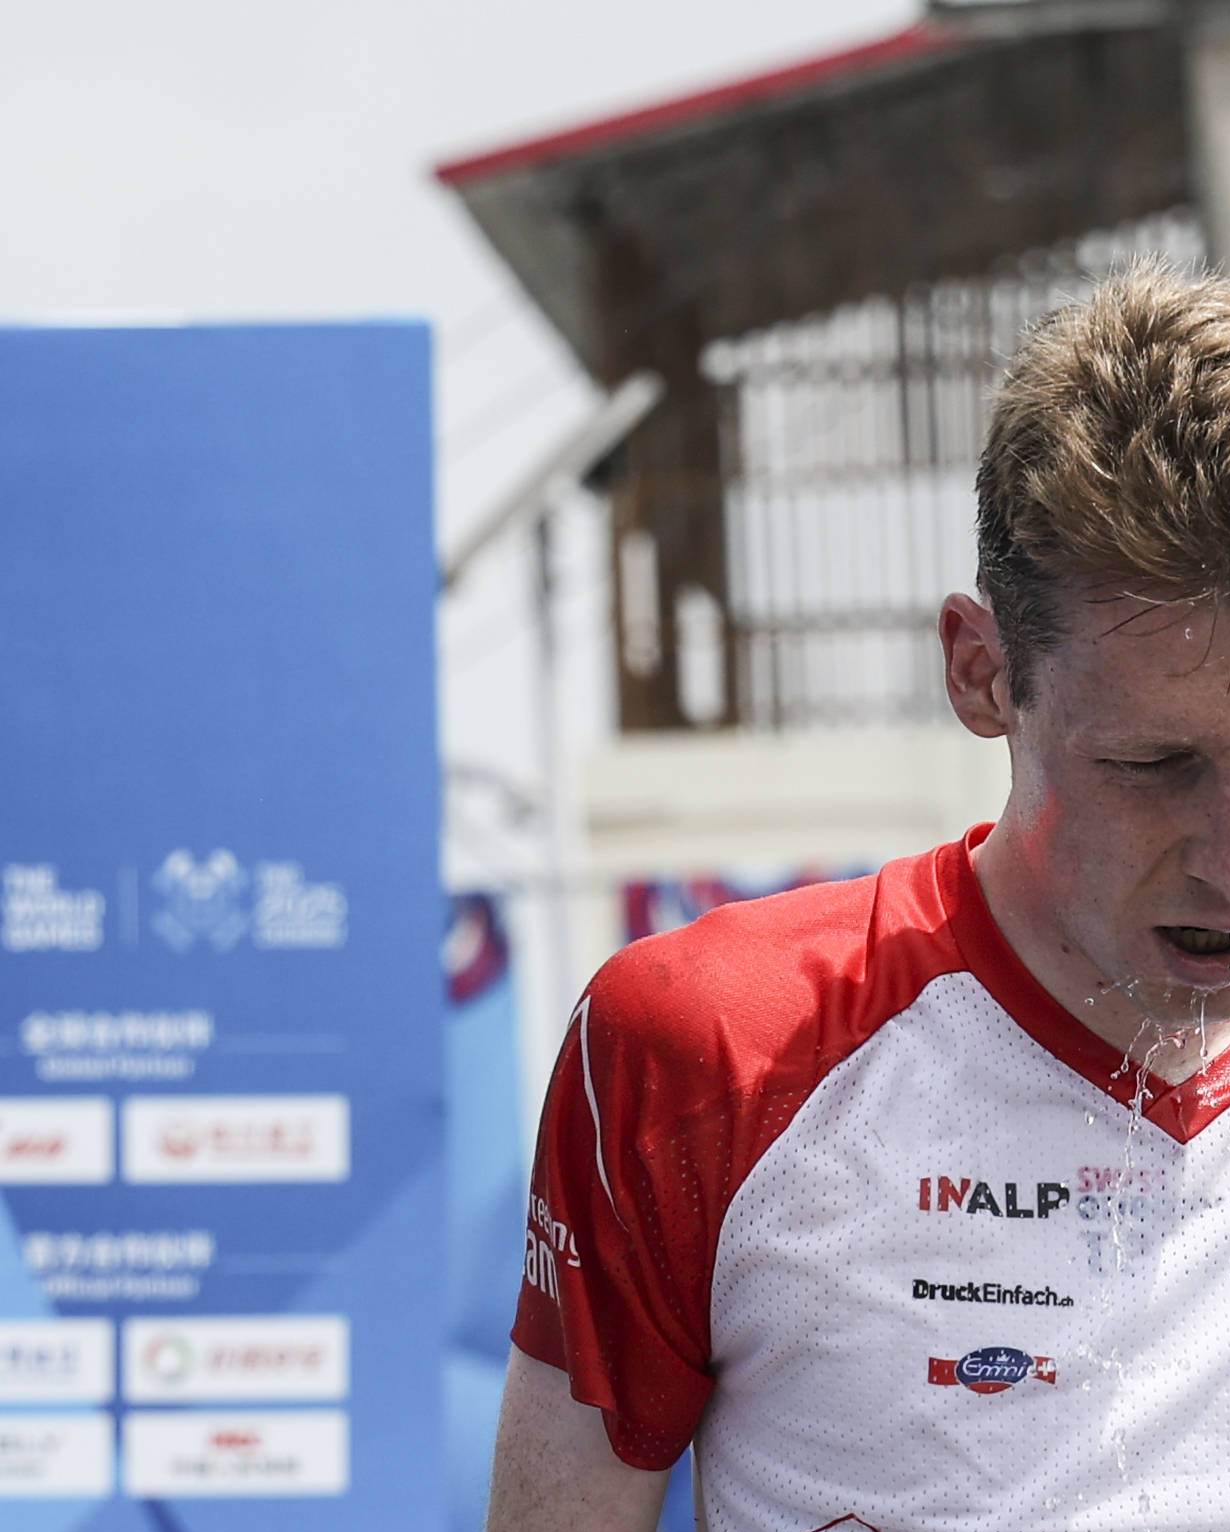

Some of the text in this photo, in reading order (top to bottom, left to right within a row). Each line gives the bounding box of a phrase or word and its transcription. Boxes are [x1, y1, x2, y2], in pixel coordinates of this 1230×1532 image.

[919, 1175, 1071, 1219] INALP
[912, 1279, 1074, 1307] DruckEinfach.ch
[962, 1356, 1028, 1377] Emmi
